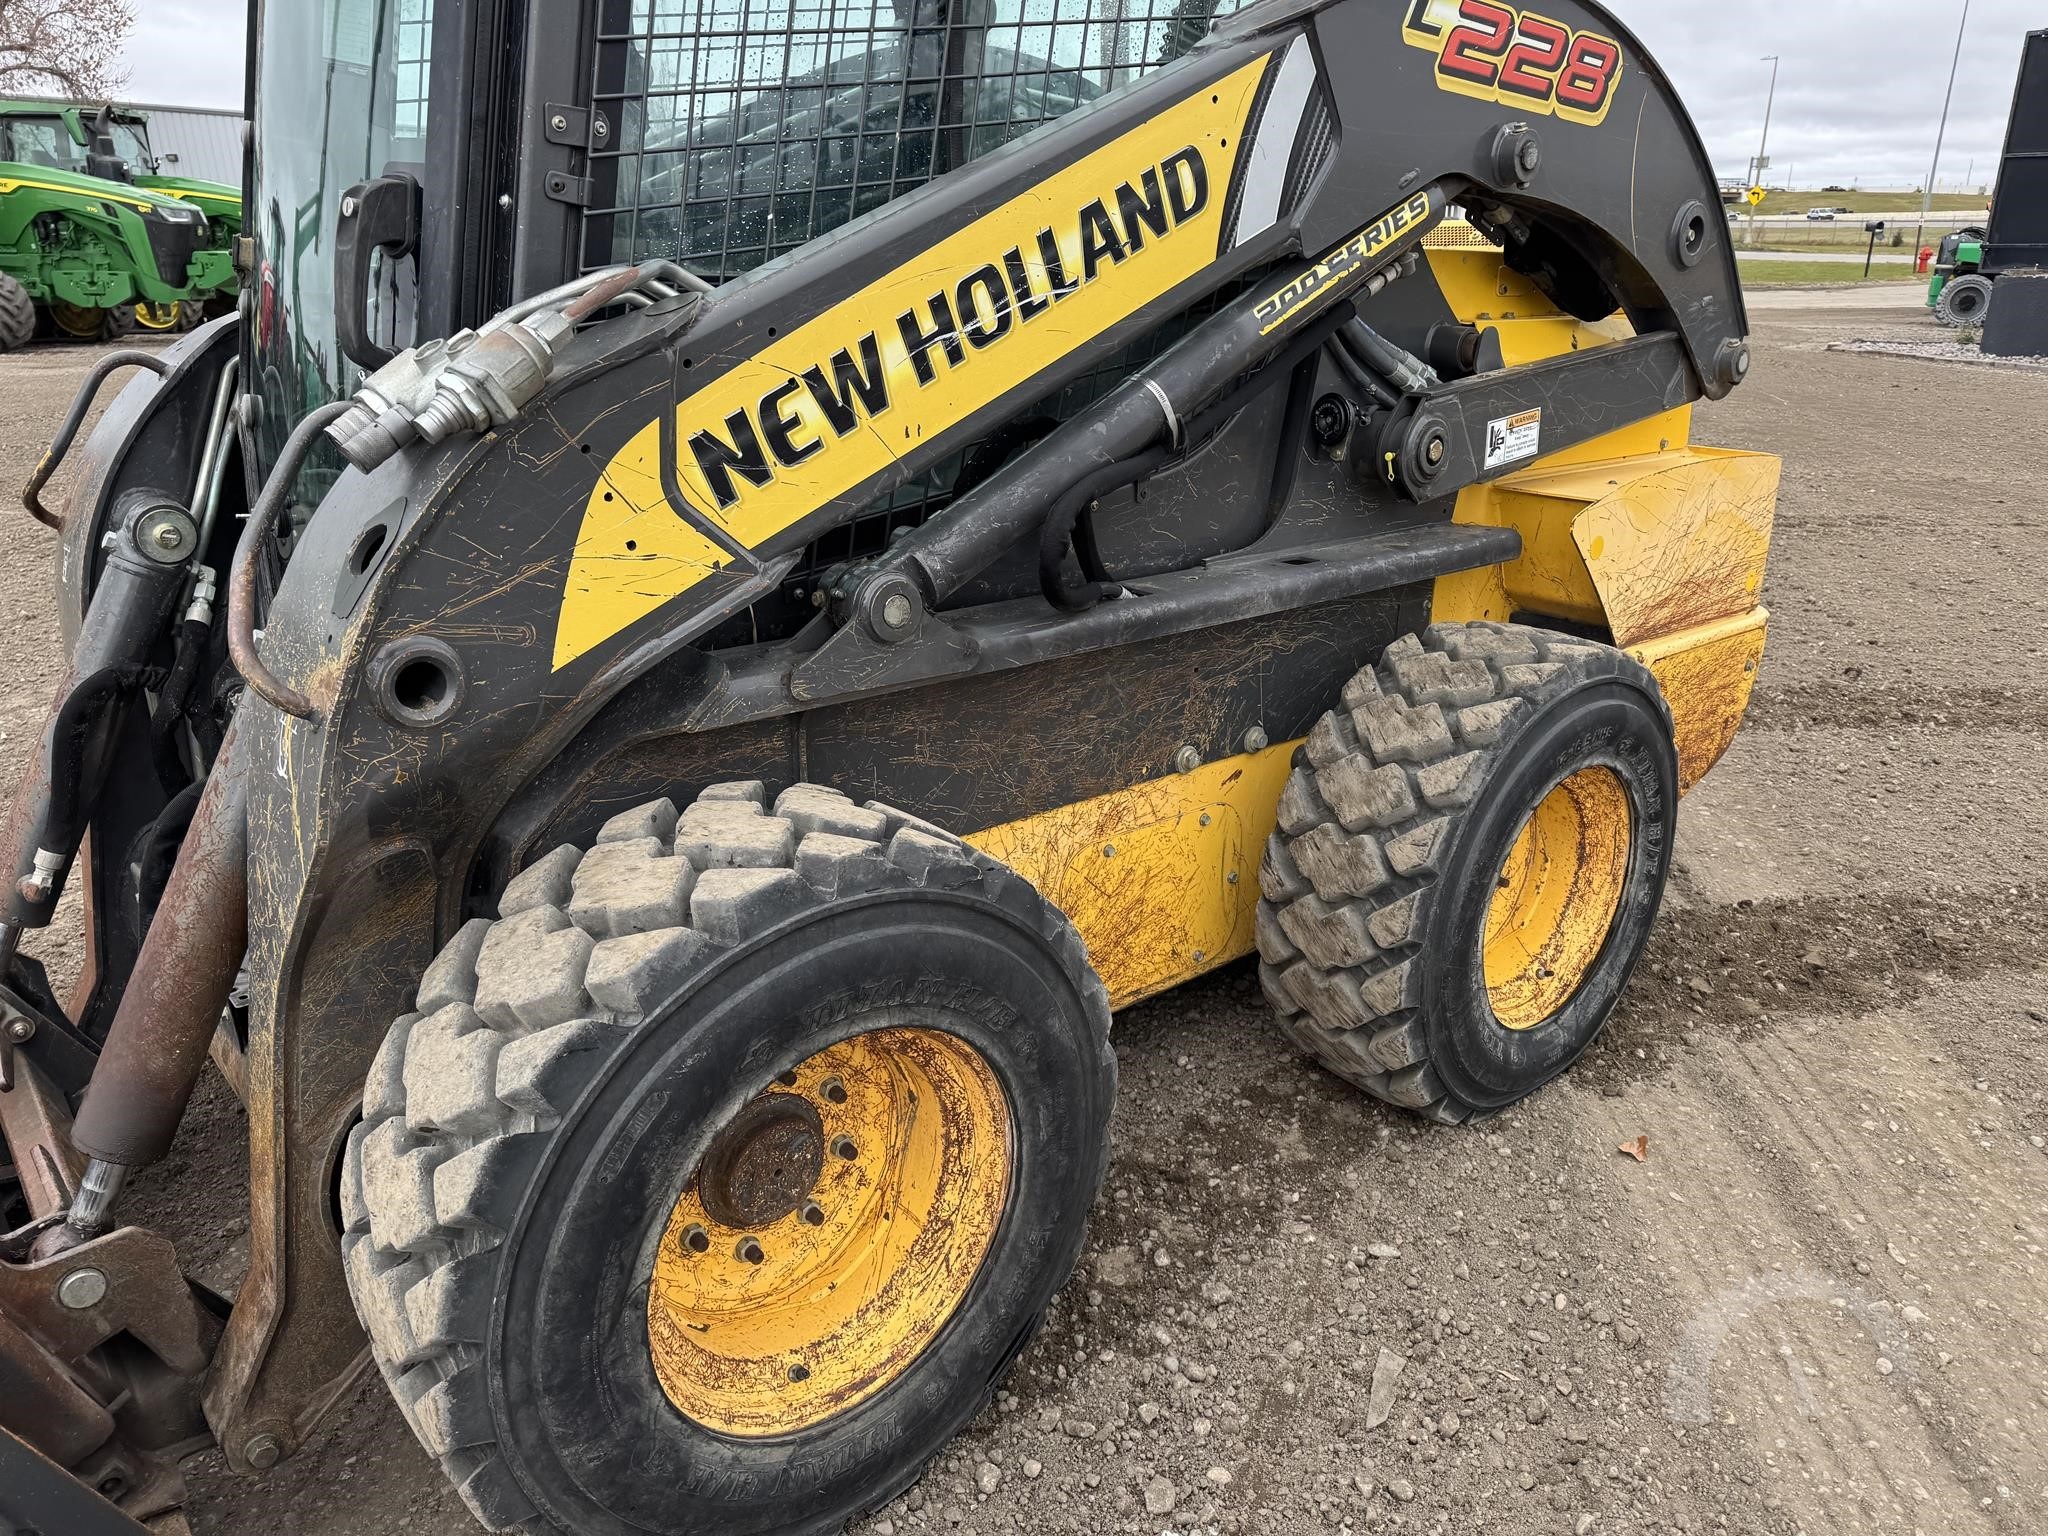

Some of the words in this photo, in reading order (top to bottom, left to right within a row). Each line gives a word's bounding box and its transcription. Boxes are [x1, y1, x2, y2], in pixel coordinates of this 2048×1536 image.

[686, 330, 892, 510] NEW
[895, 144, 1211, 388] HOLLAND
[1513, 412, 1538, 425] WARNING
